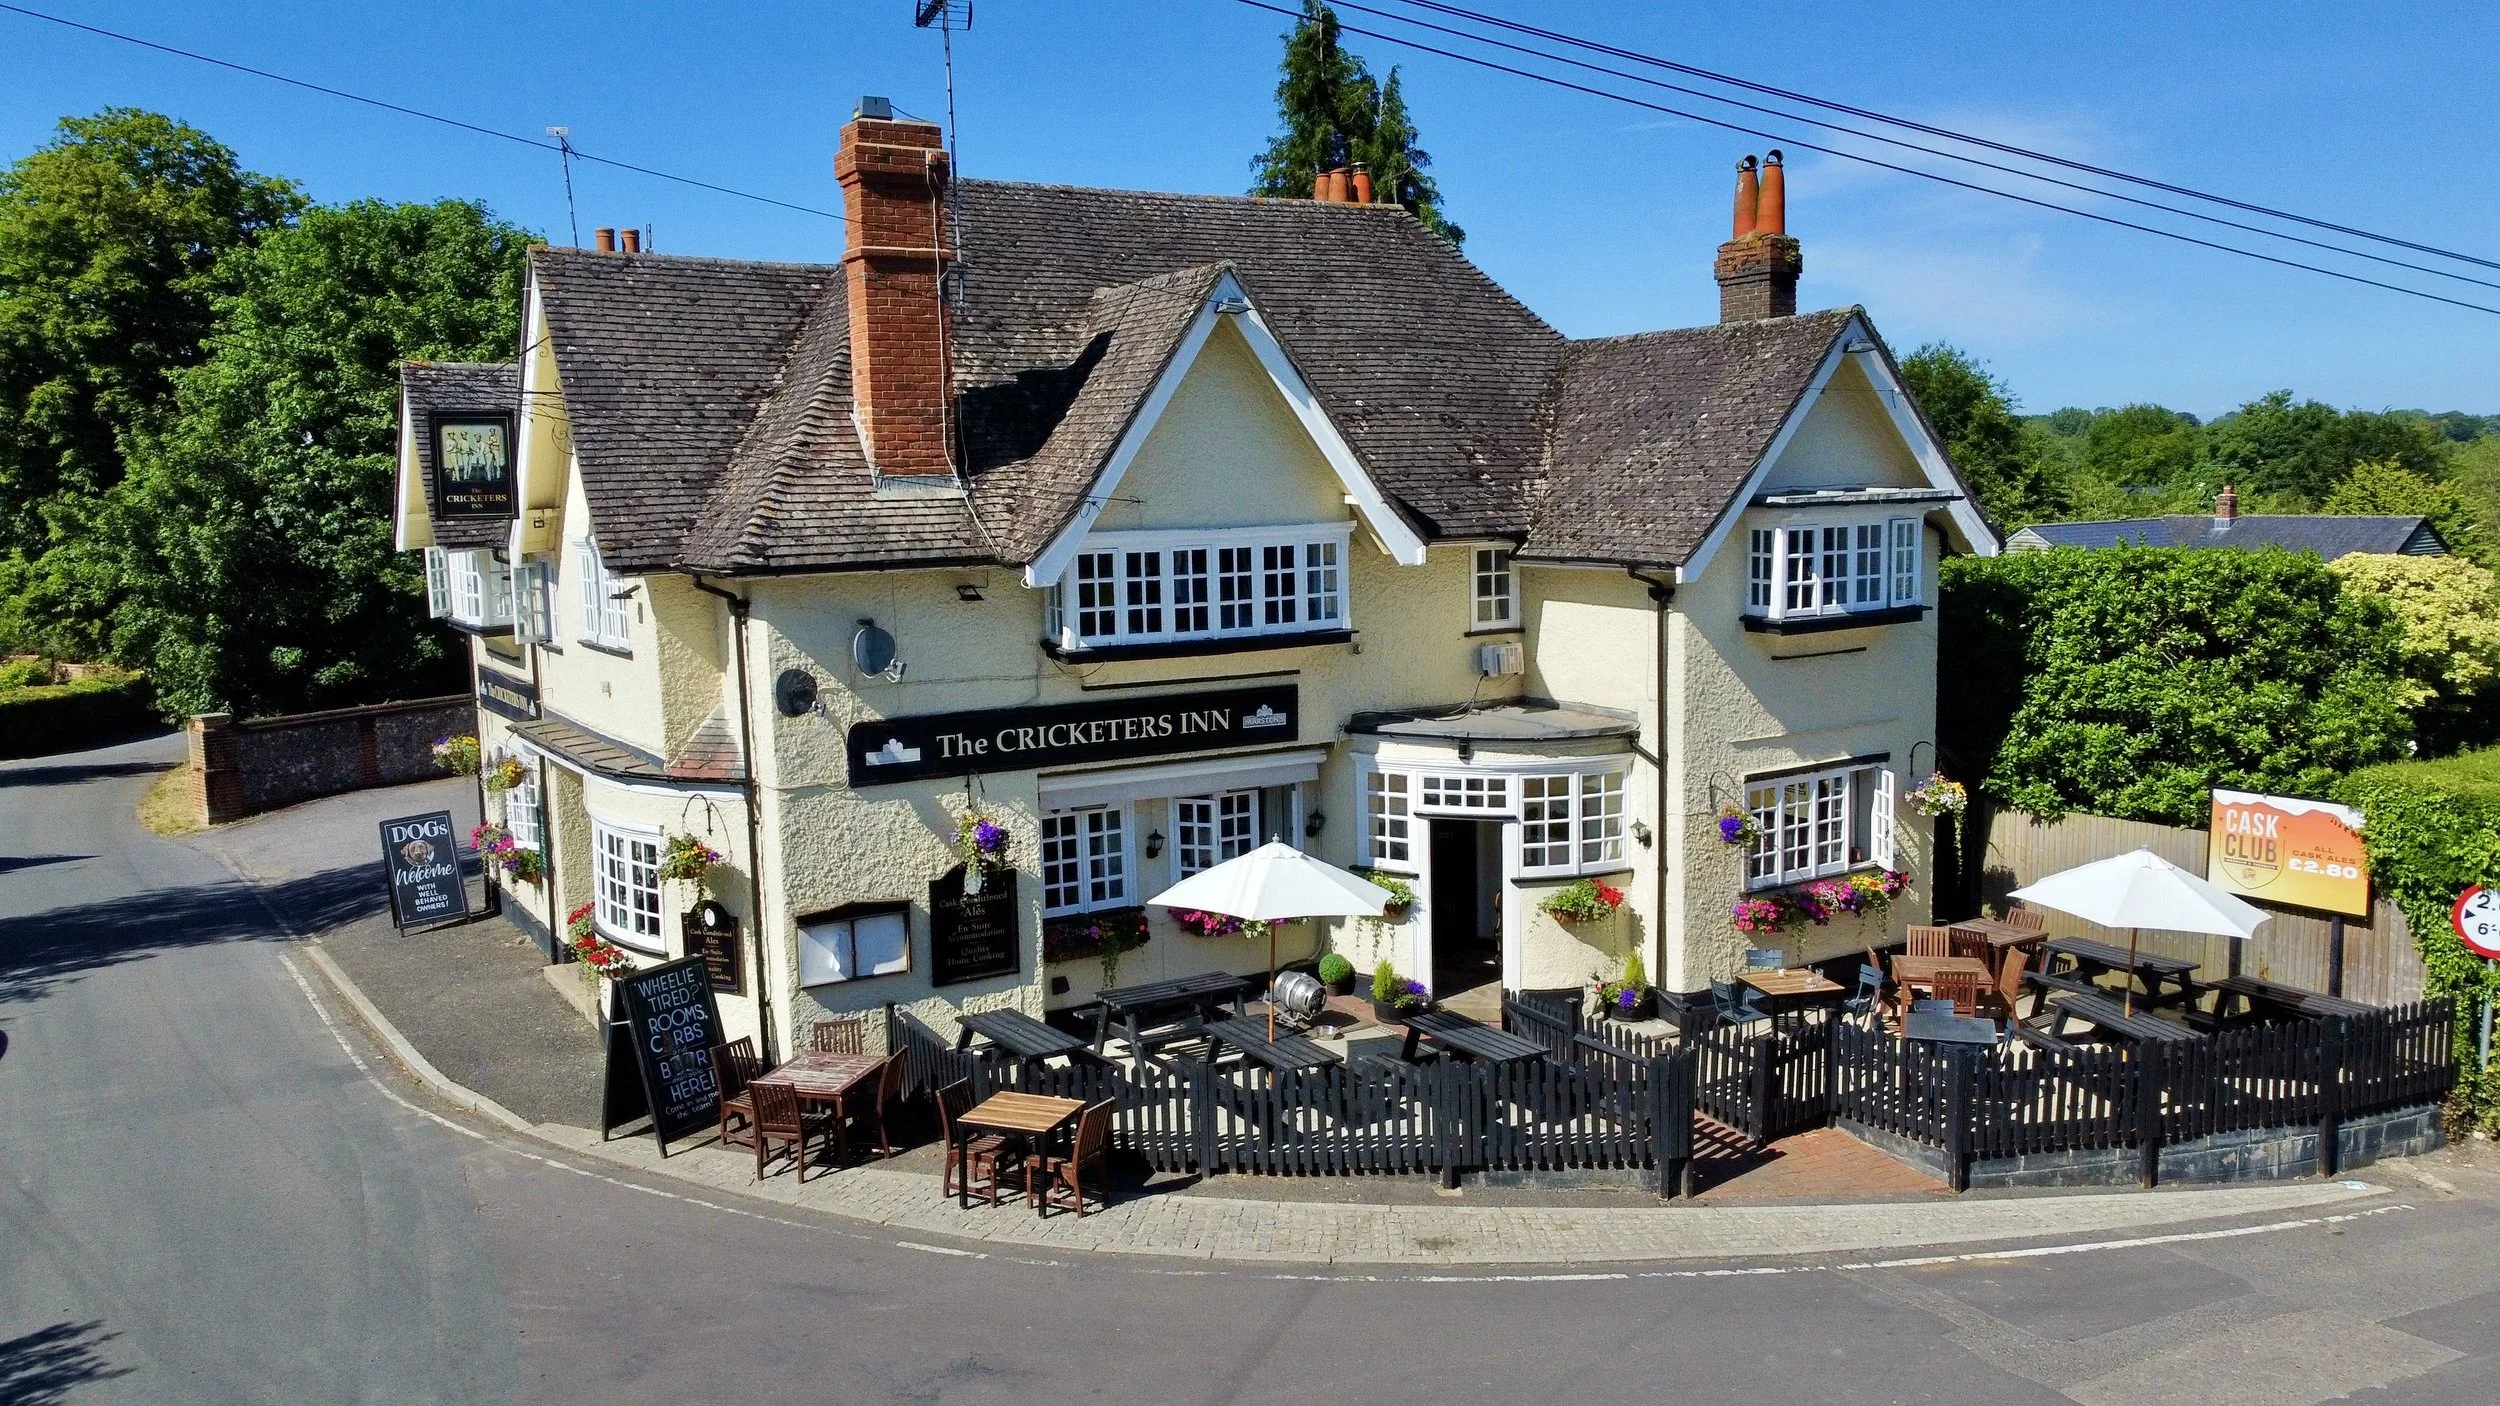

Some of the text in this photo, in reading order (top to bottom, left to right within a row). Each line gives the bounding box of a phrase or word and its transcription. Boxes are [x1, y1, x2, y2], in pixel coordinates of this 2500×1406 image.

[446, 494, 507, 502] CRICKETERS
[936, 708, 1231, 758] The CRICKETERS INN
[2226, 808, 2280, 838] CASK
[392, 820, 448, 842] DOGs
[2225, 833, 2277, 863] CLUB
[2314, 846, 2334, 854] ALL
[2292, 850, 2356, 865] CASK ALES
[396, 863, 456, 886] Welcome
[415, 894, 448, 906] BEHAVED
[418, 890, 439, 898] WELL
[417, 900, 449, 912] OWNERS!
[2476, 894, 2500, 911] 2.
[964, 907, 986, 918] Ales
[960, 945, 991, 957] Quality
[947, 951, 1005, 967] Home Cooking
[711, 973, 732, 981] Cooking
[648, 1004, 708, 1033] ROOMS,
[670, 1070, 716, 1102] HERE!
[666, 1104, 686, 1115] Come
